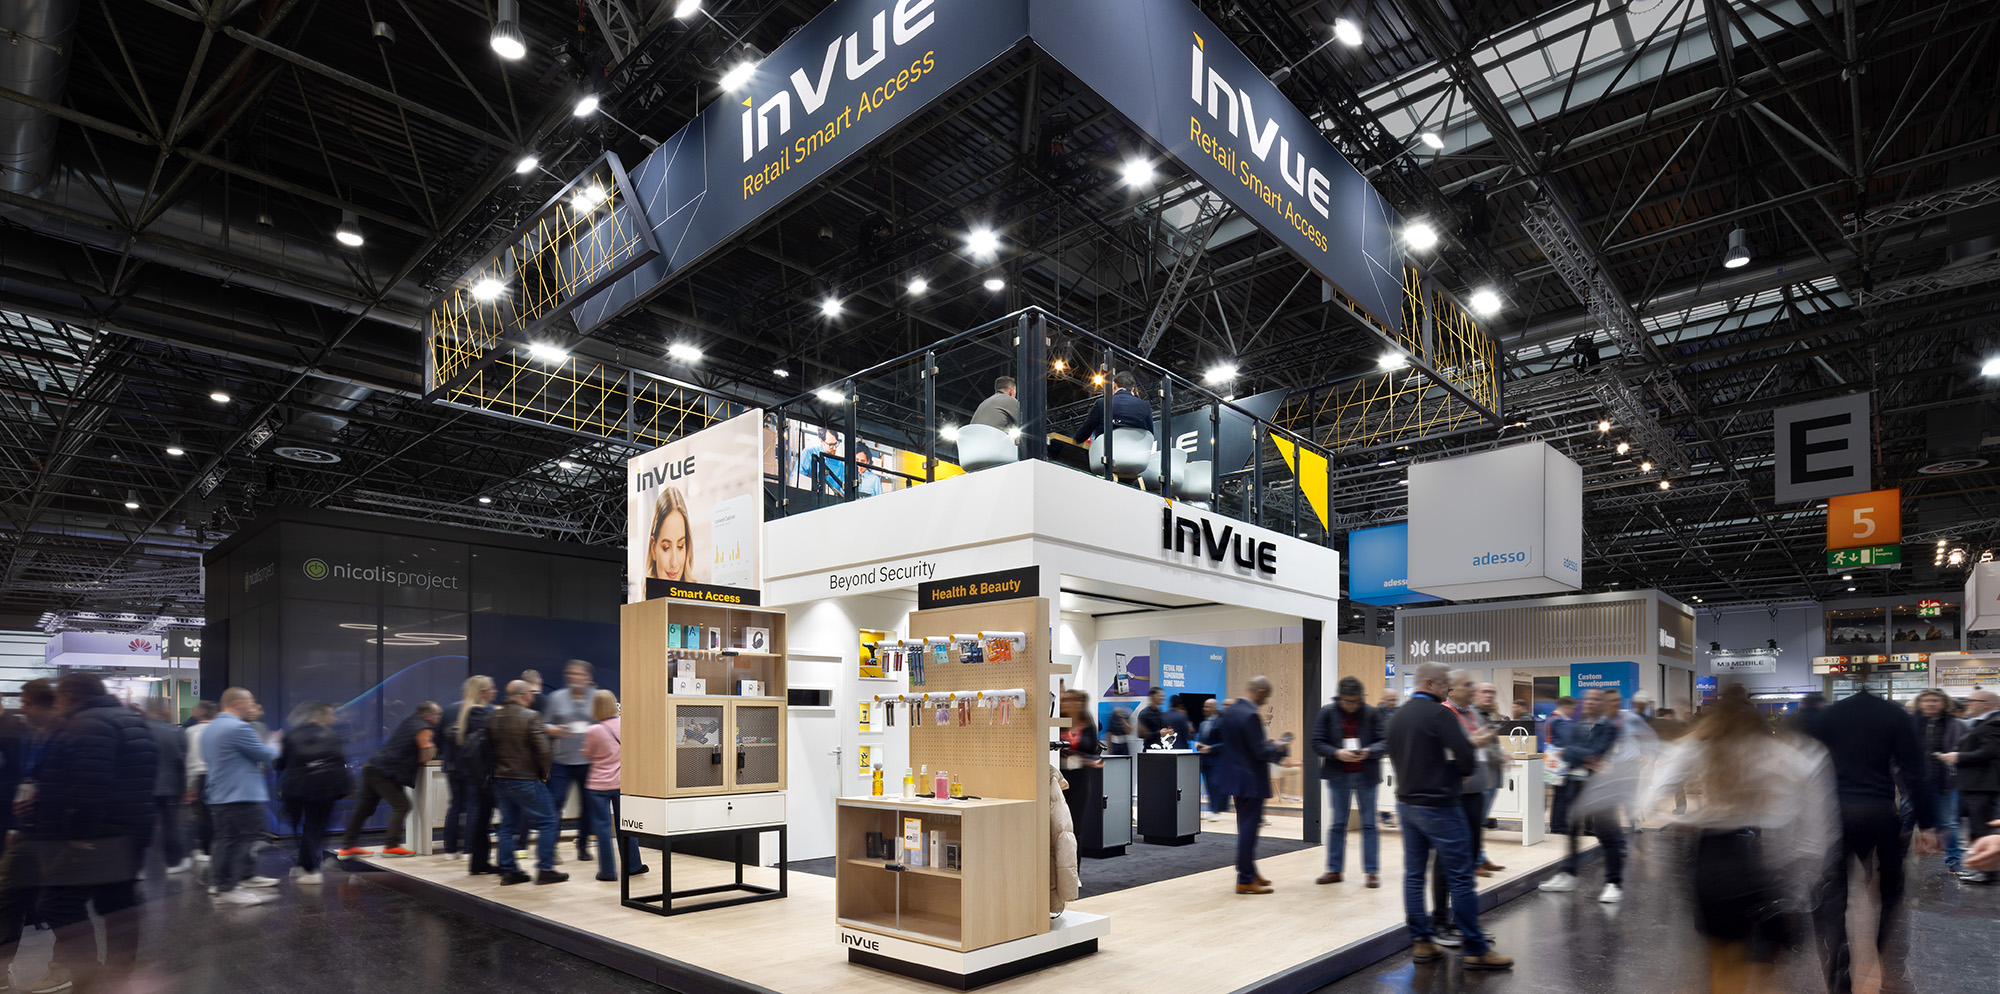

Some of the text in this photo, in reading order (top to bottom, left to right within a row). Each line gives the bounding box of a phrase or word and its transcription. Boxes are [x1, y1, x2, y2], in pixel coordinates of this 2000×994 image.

[743, 50, 935, 201] Retail Smart Access
[1190, 116, 1328, 253] Retail Smart Access
[1790, 412, 1854, 485] E
[1852, 507, 1876, 539] 5
[1473, 551, 1526, 566] adesso
[334, 563, 459, 590] nicolisproject
[829, 560, 936, 592] Beyond Security
[670, 586, 741, 604] Smart Access
[931, 579, 1021, 601] Health & Beauty
[1435, 640, 1490, 655] keonn
[1577, 679, 1621, 688] Development
